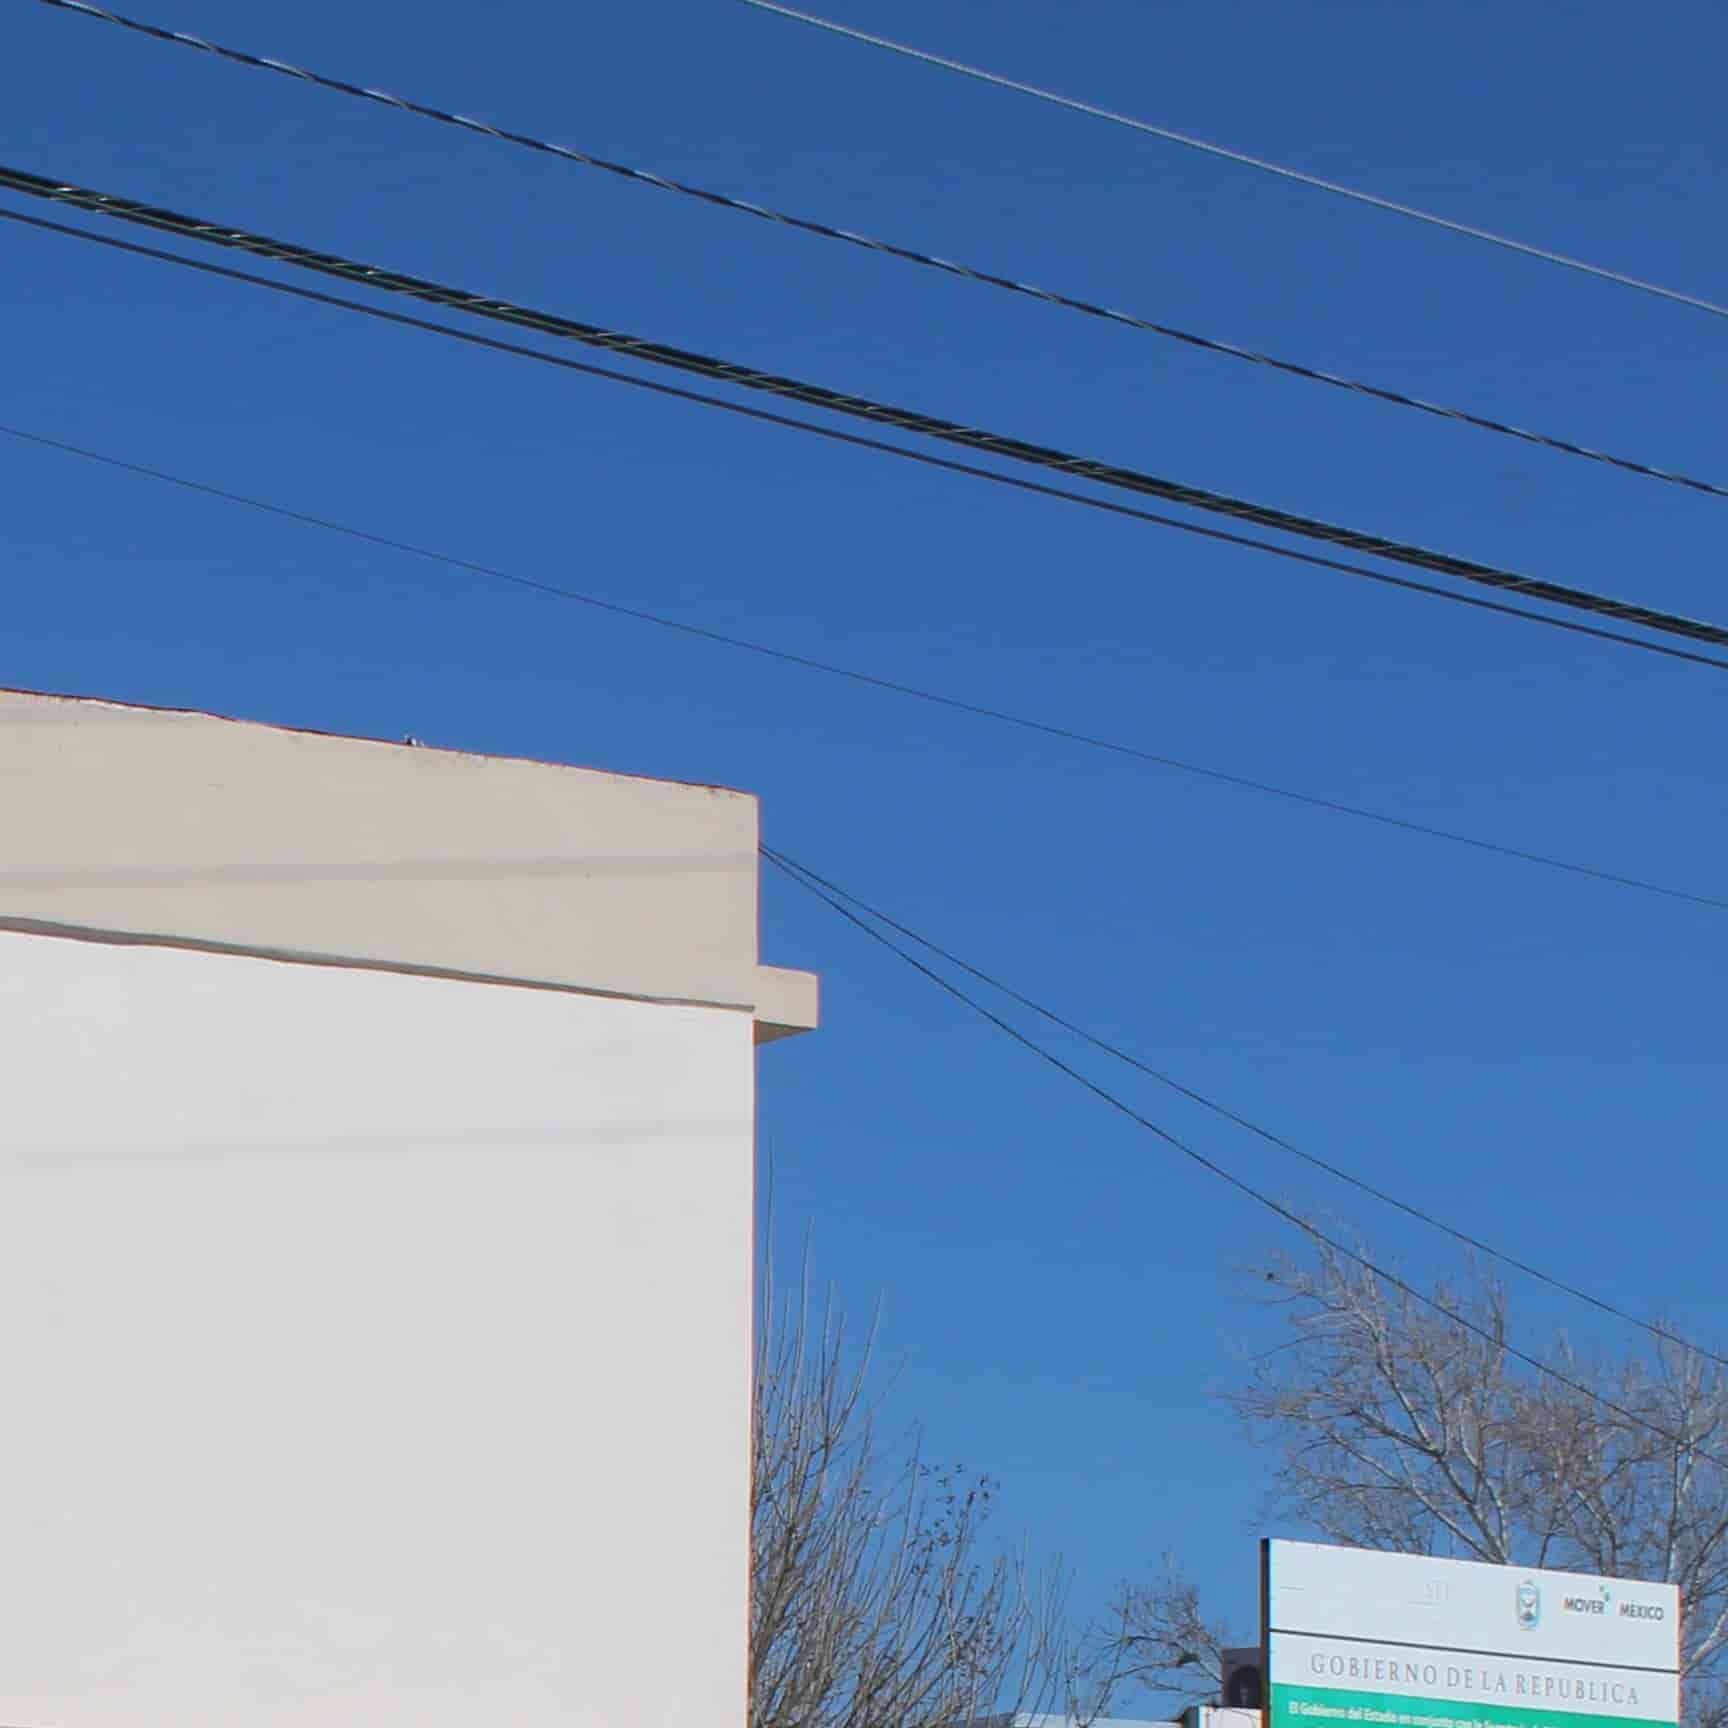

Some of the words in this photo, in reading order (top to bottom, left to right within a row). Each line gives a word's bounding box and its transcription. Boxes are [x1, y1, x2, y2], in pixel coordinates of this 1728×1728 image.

[1563, 1596, 1606, 1616] MOVER
[1310, 1652, 1438, 1686] GOBIERNO
[1446, 1666, 1474, 1690] DE
[1480, 1670, 1507, 1693] LA
